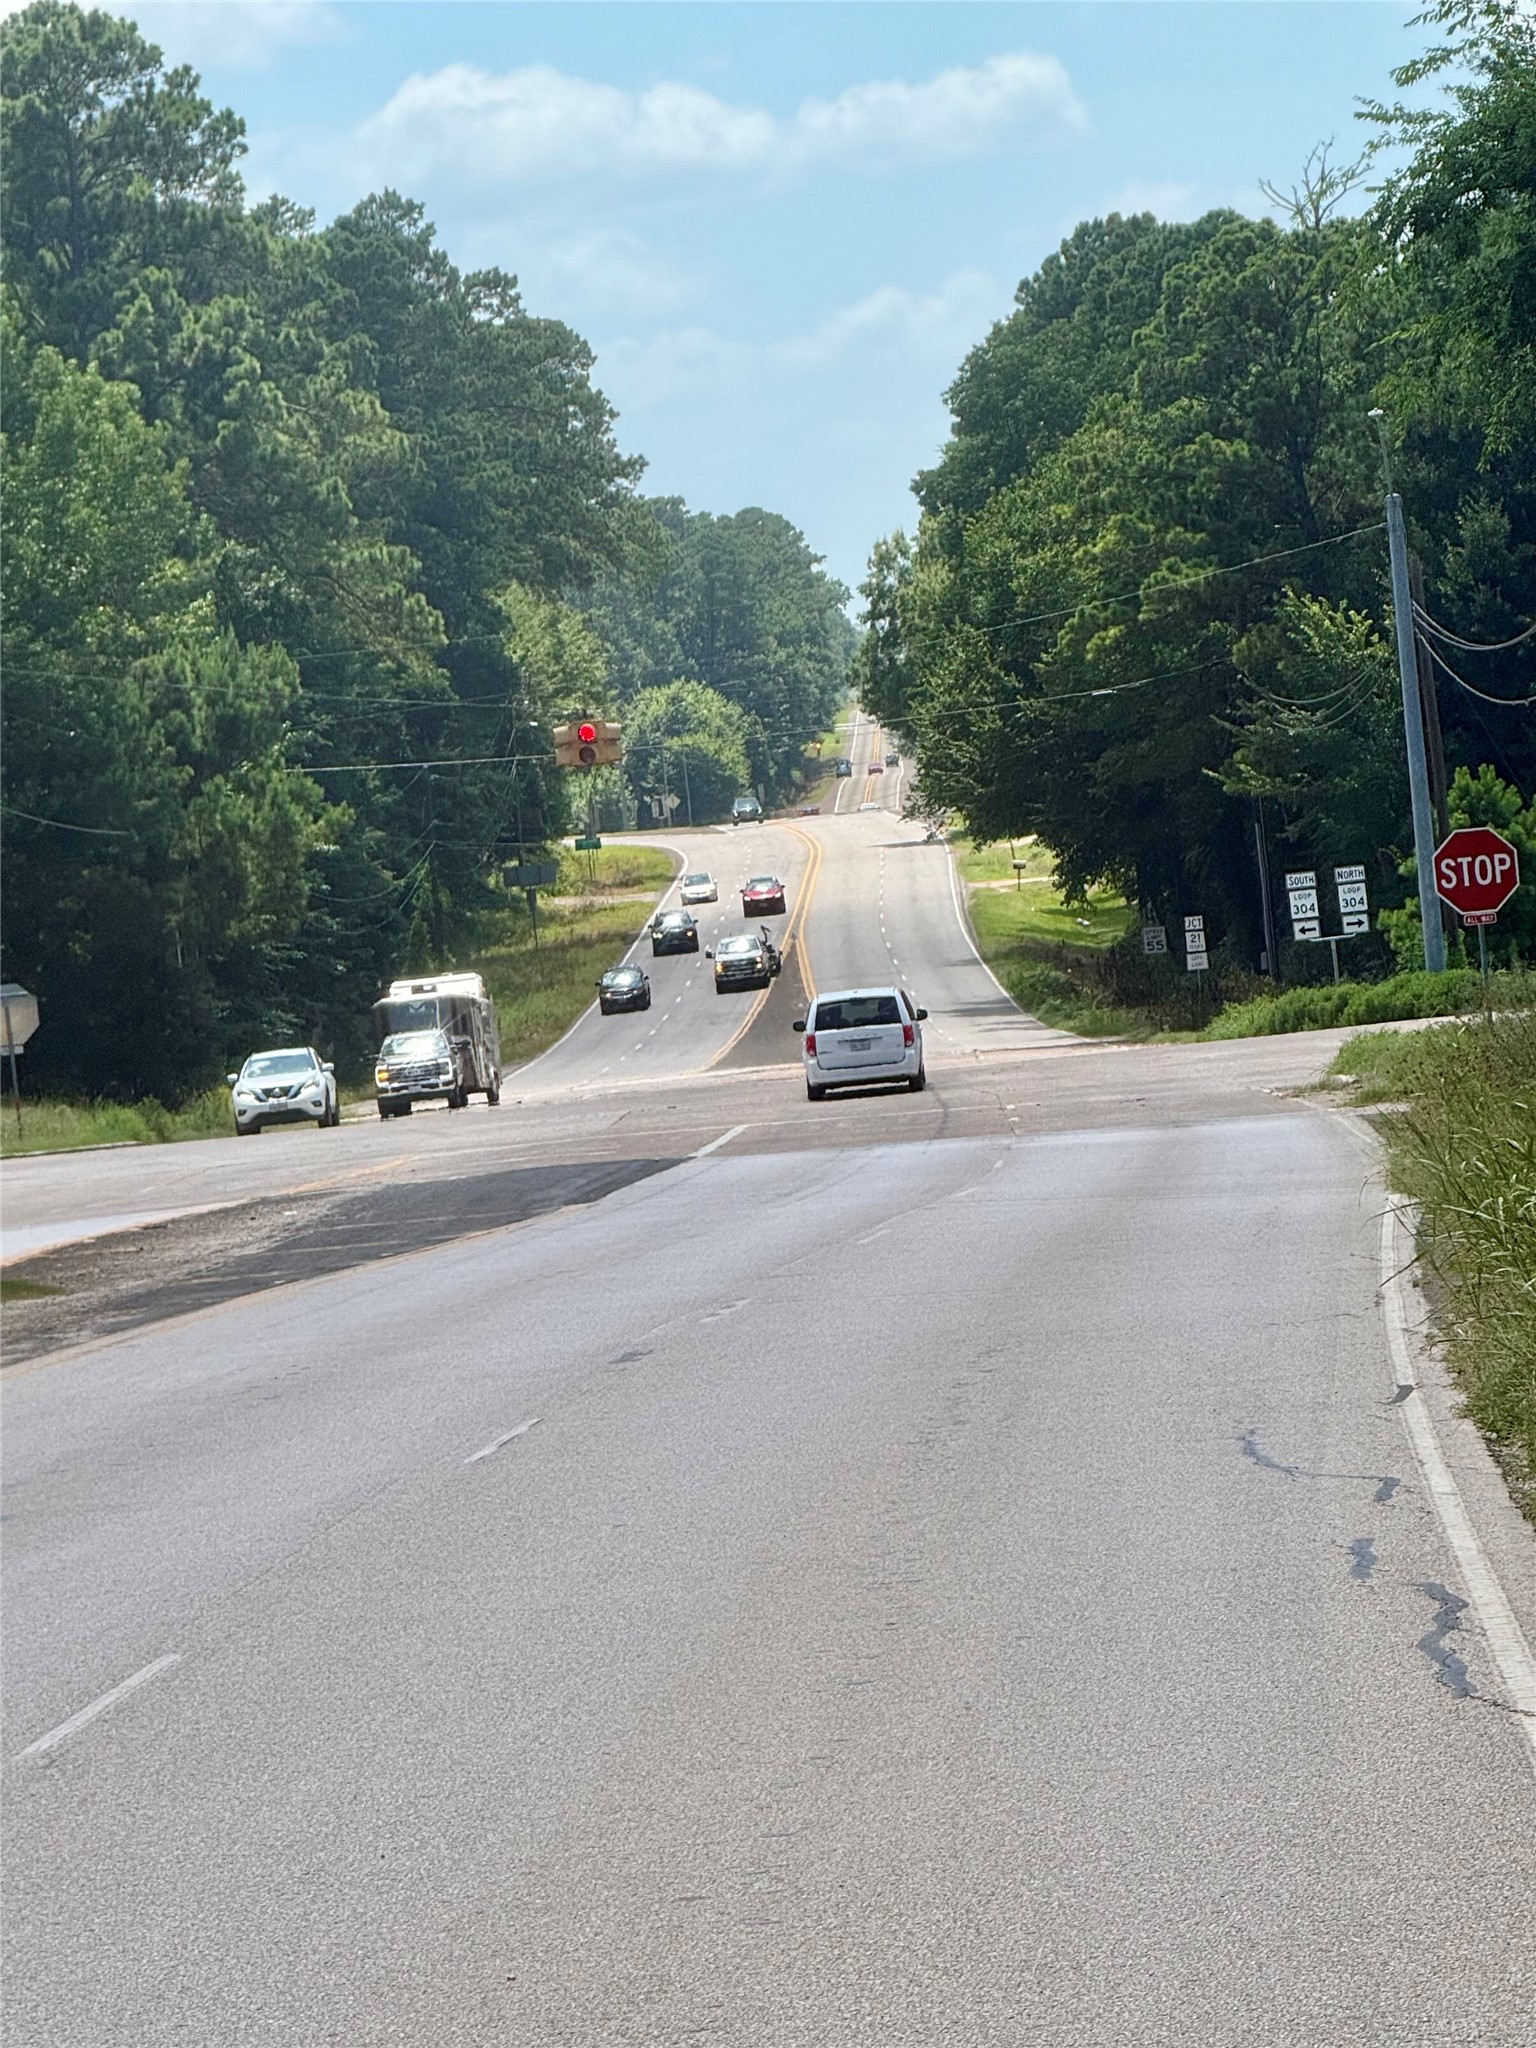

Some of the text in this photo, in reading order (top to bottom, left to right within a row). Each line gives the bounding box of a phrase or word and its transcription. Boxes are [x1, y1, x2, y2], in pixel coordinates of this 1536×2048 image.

[1337, 869, 1364, 880] NORTH
[1440, 853, 1511, 889] STOP
[1288, 876, 1315, 886] SOUTH
[1343, 886, 1361, 894] LOOP
[1293, 892, 1312, 900] LOOP
[1342, 897, 1365, 908] 304
[1293, 903, 1316, 915] 304
[1187, 918, 1202, 928] JCT
[1190, 933, 1201, 943] 21
[1146, 940, 1165, 951] 55
